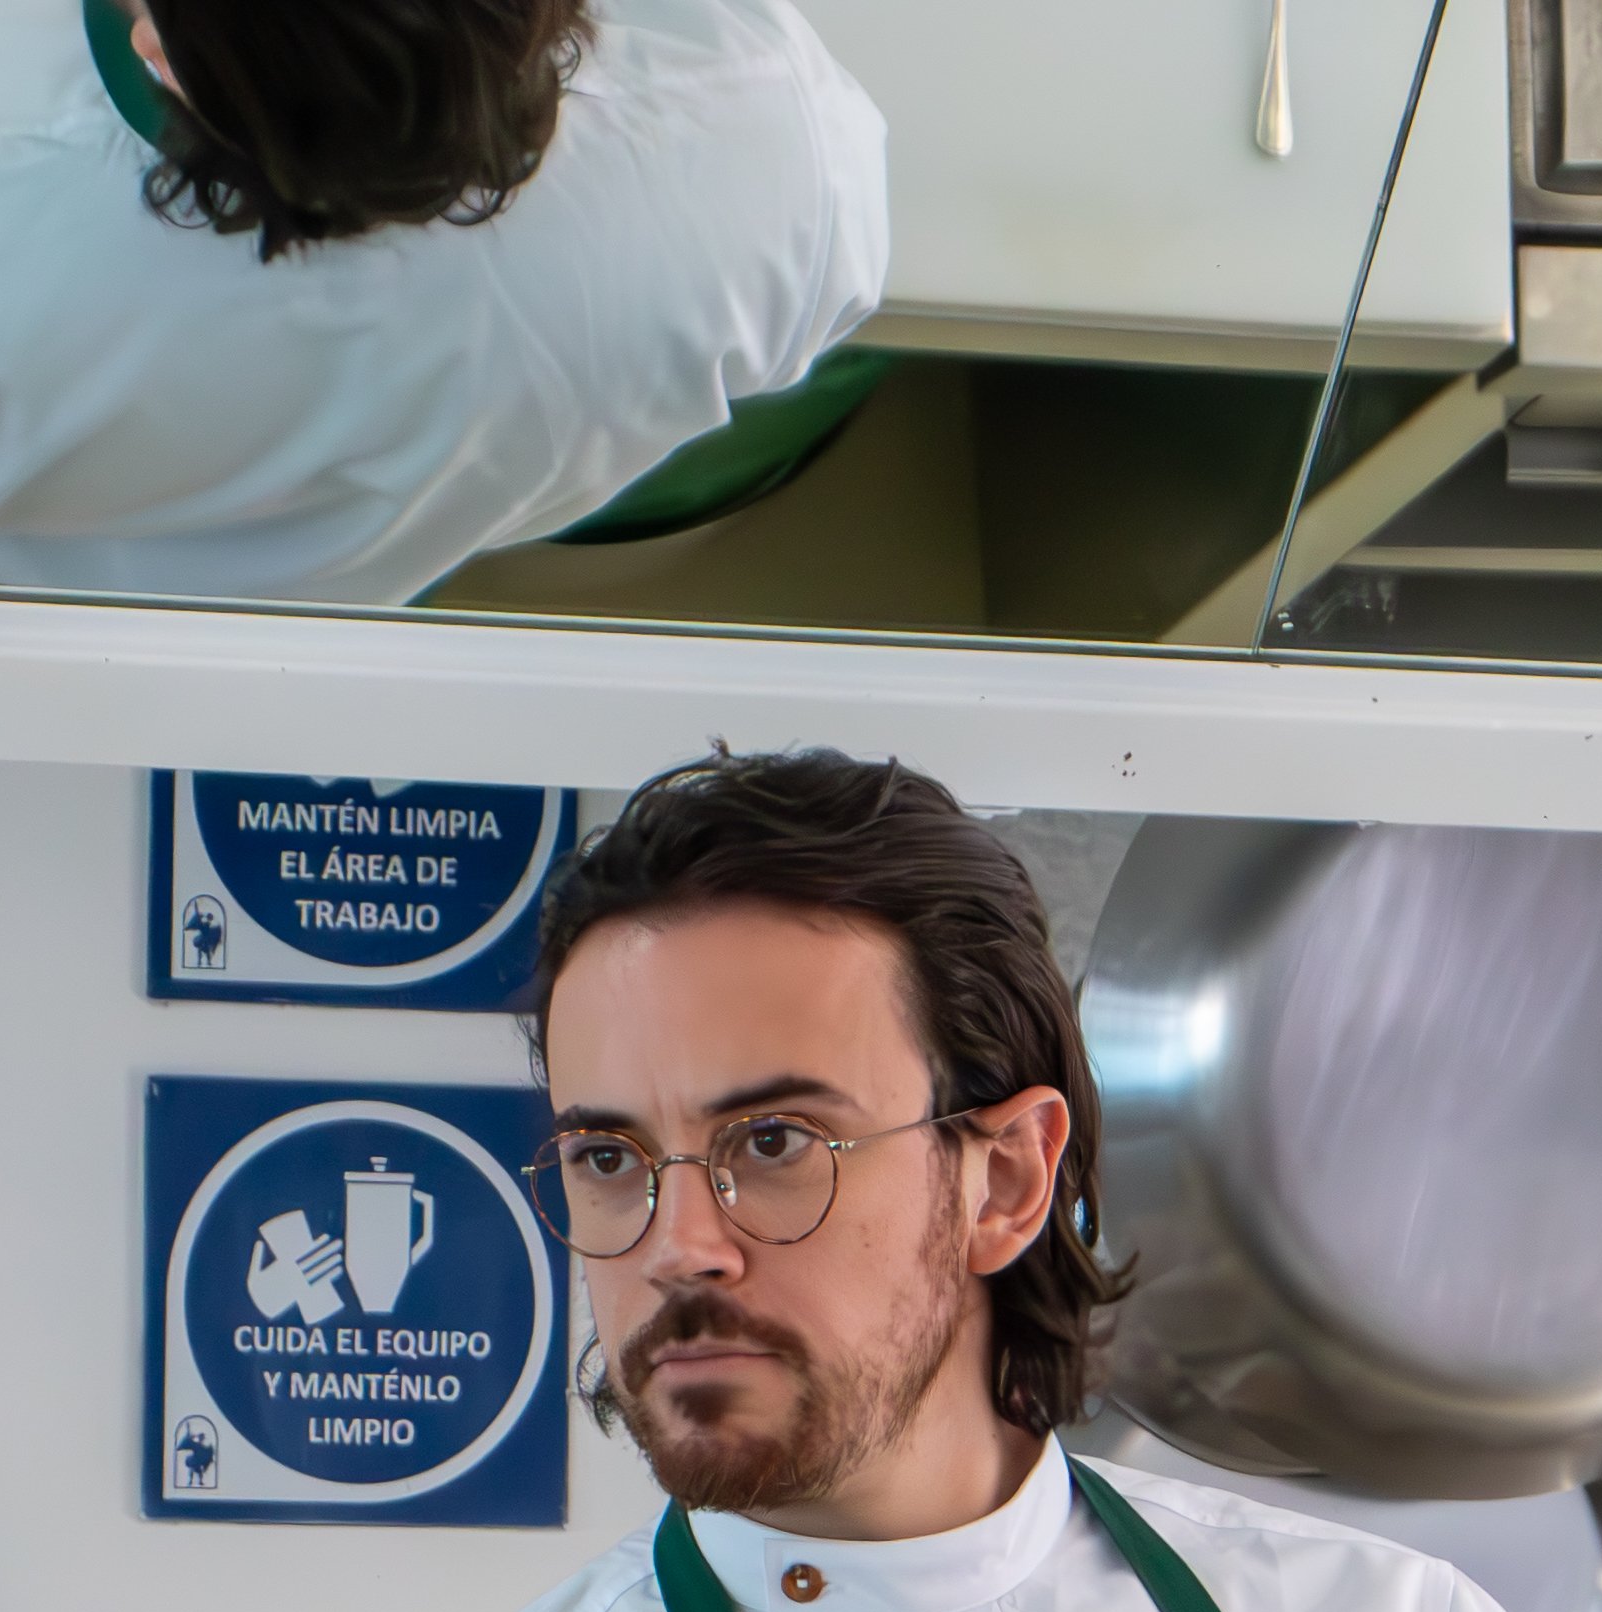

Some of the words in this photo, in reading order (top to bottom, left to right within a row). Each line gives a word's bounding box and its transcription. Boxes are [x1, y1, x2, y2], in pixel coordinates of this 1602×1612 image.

[238, 798, 379, 836] MANTÉN
[389, 806, 502, 838] LIMPIA
[280, 850, 314, 880] EL
[321, 845, 408, 884] ÁREA
[416, 856, 458, 886] DE
[295, 899, 441, 932] TRABAJO
[233, 1325, 328, 1355] CUIDA
[337, 1328, 368, 1355] EL
[377, 1329, 491, 1360] EQUIPO
[263, 1371, 282, 1398] Y
[290, 1367, 461, 1402] MANTÉNLO
[308, 1417, 415, 1445] LIMPIO
